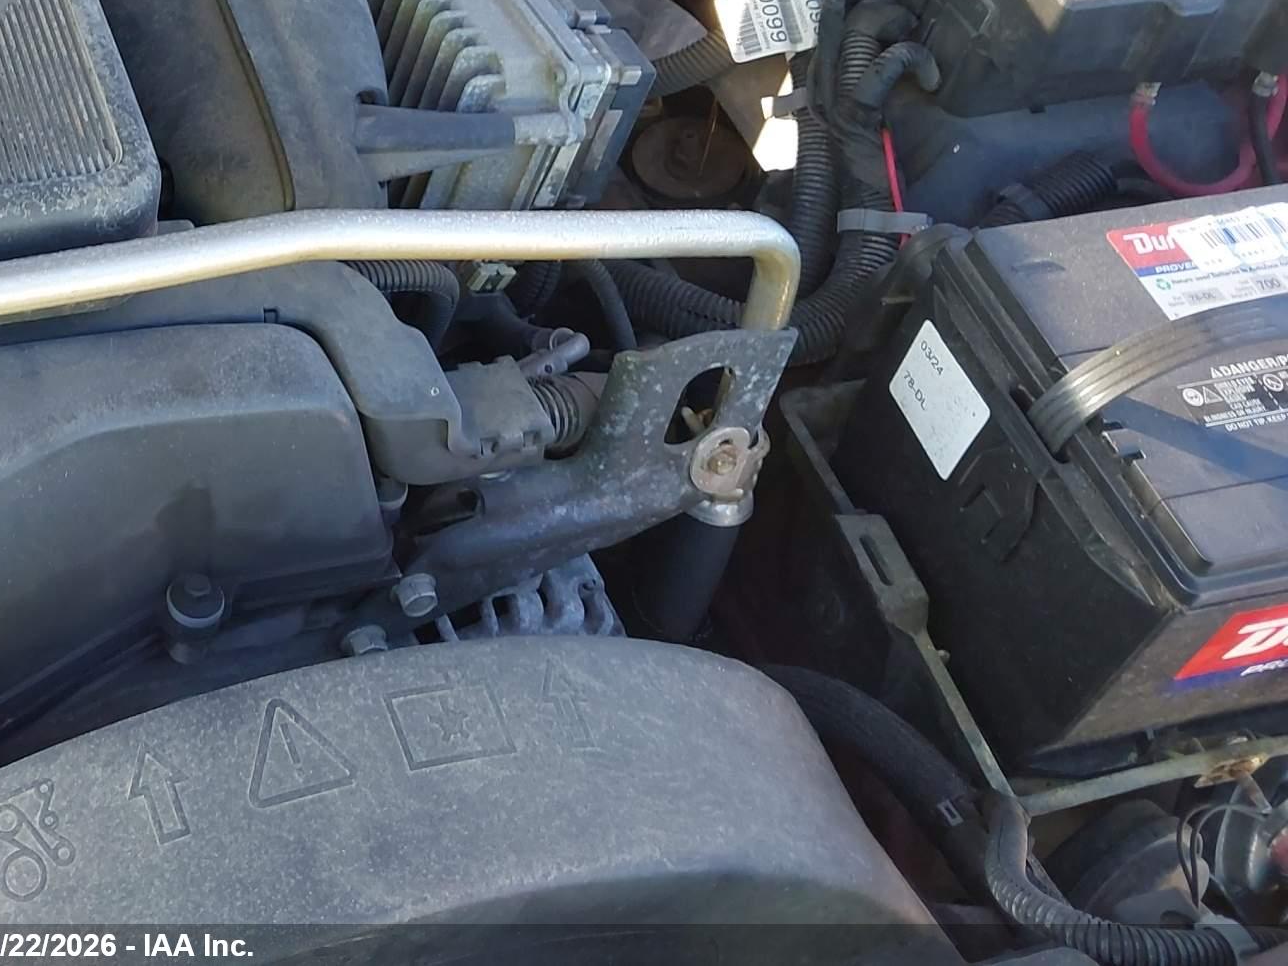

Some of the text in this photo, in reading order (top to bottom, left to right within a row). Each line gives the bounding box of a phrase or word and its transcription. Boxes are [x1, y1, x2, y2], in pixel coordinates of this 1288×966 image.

[1255, 277, 1281, 291] 700
[921, 340, 943, 375] 03/24
[1219, 354, 1288, 377] DANGER/P
